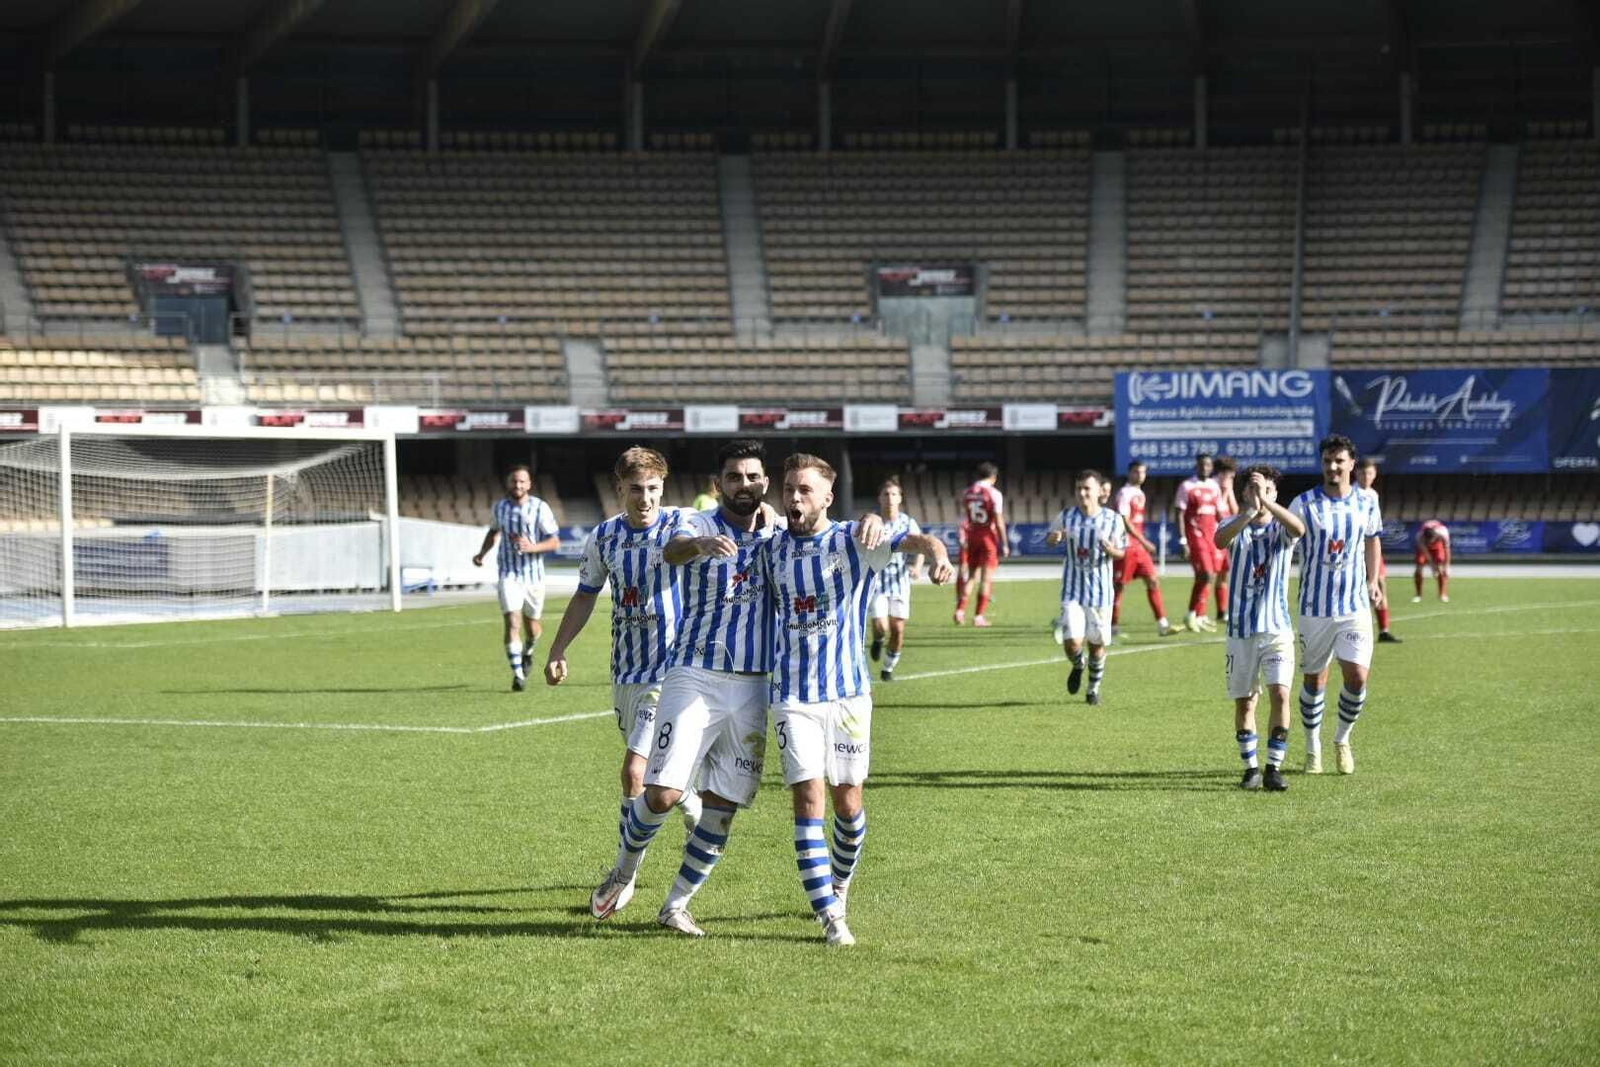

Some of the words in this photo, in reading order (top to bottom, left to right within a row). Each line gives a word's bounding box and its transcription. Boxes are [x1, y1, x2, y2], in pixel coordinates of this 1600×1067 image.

[1163, 371, 1314, 398] JIMANG
[1554, 458, 1598, 468] OFERTA
[968, 501, 988, 524] 15
[658, 722, 673, 749] 8
